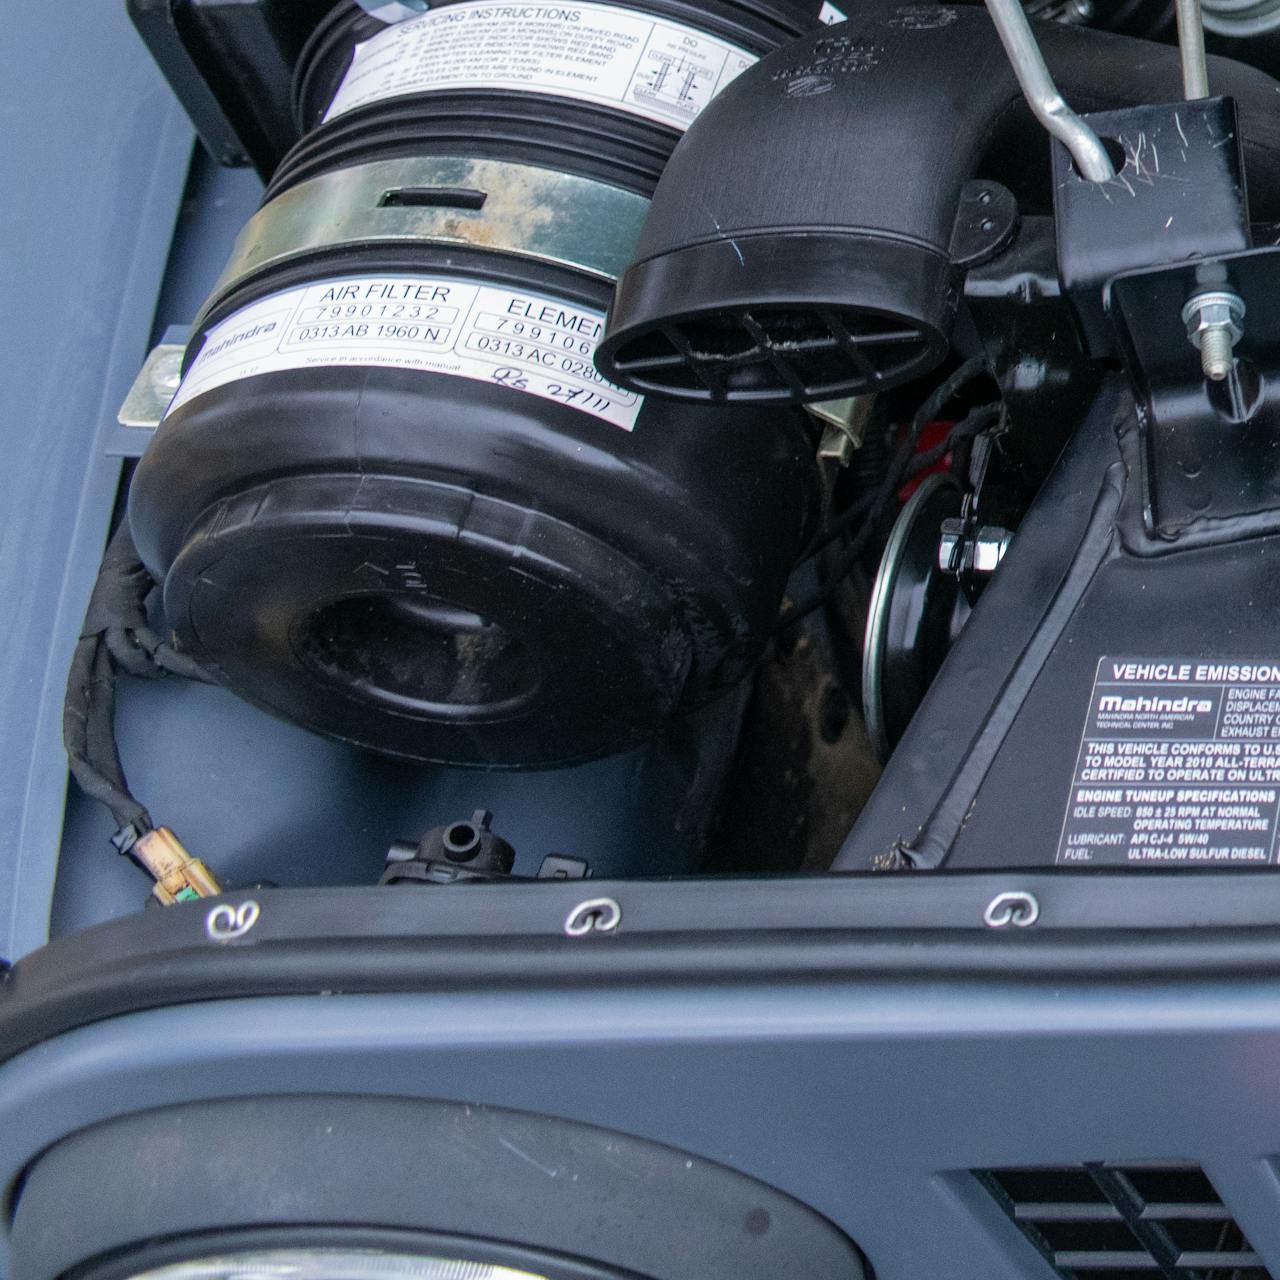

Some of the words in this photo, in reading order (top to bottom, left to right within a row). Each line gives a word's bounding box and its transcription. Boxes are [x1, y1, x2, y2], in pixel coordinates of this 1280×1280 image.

[470, 6, 582, 21] INSTRUCTIONS
[682, 36, 699, 48] DO
[320, 285, 363, 303] AIR
[365, 283, 451, 303] FILTER
[299, 325, 341, 341] 0313
[342, 323, 369, 337] AB
[377, 324, 420, 339] 1960
[424, 326, 440, 340] N
[477, 336, 524, 357] 0313
[527, 349, 556, 367] AC
[305, 356, 338, 365] Service
[339, 355, 348, 363] in
[349, 355, 401, 365] accordance
[404, 358, 423, 366] with
[425, 360, 462, 371] manual
[1113, 664, 1191, 680] VEHICLE
[1228, 689, 1267, 700] ENGINE
[1096, 721, 1132, 729] TECHNICAL
[1223, 714, 1274, 725] COUNTRY
[1221, 726, 1269, 738] EXHAUST
[1087, 743, 1114, 755] THIS
[1117, 743, 1169, 755] VEHICLE
[1171, 743, 1241, 756] CONFORMS
[1244, 743, 1260, 755] TO
[1085, 756, 1101, 768] TO
[1103, 756, 1146, 768] MODEL
[1149, 756, 1184, 768] YEAR
[1081, 769, 1145, 781] CERTIFIED
[1148, 769, 1164, 781] TO
[1166, 769, 1225, 781] OPERATE
[1227, 769, 1246, 781] ON
[1076, 789, 1122, 803] ENGINE
[1125, 789, 1175, 803] TUNEUP
[1176, 790, 1276, 803] SPECIFICATIONS
[1073, 806, 1096, 818] IDLE
[1097, 806, 1133, 818] SPEED:
[1177, 806, 1200, 818] RPM
[1201, 806, 1215, 818] AT
[1216, 807, 1260, 818] NORMAL
[1133, 819, 1193, 831] OPERATING
[1194, 819, 1269, 831] TEMPERATURE
[1067, 833, 1126, 845] LUBRICANT:
[1130, 833, 1149, 845] API
[1150, 833, 1174, 845] CJ-4
[1064, 848, 1094, 860] FUEL:
[1128, 848, 1188, 859] ULTRA-LOW
[1189, 848, 1231, 860] SULFUR
[1231, 848, 1266, 860] DIESEL
